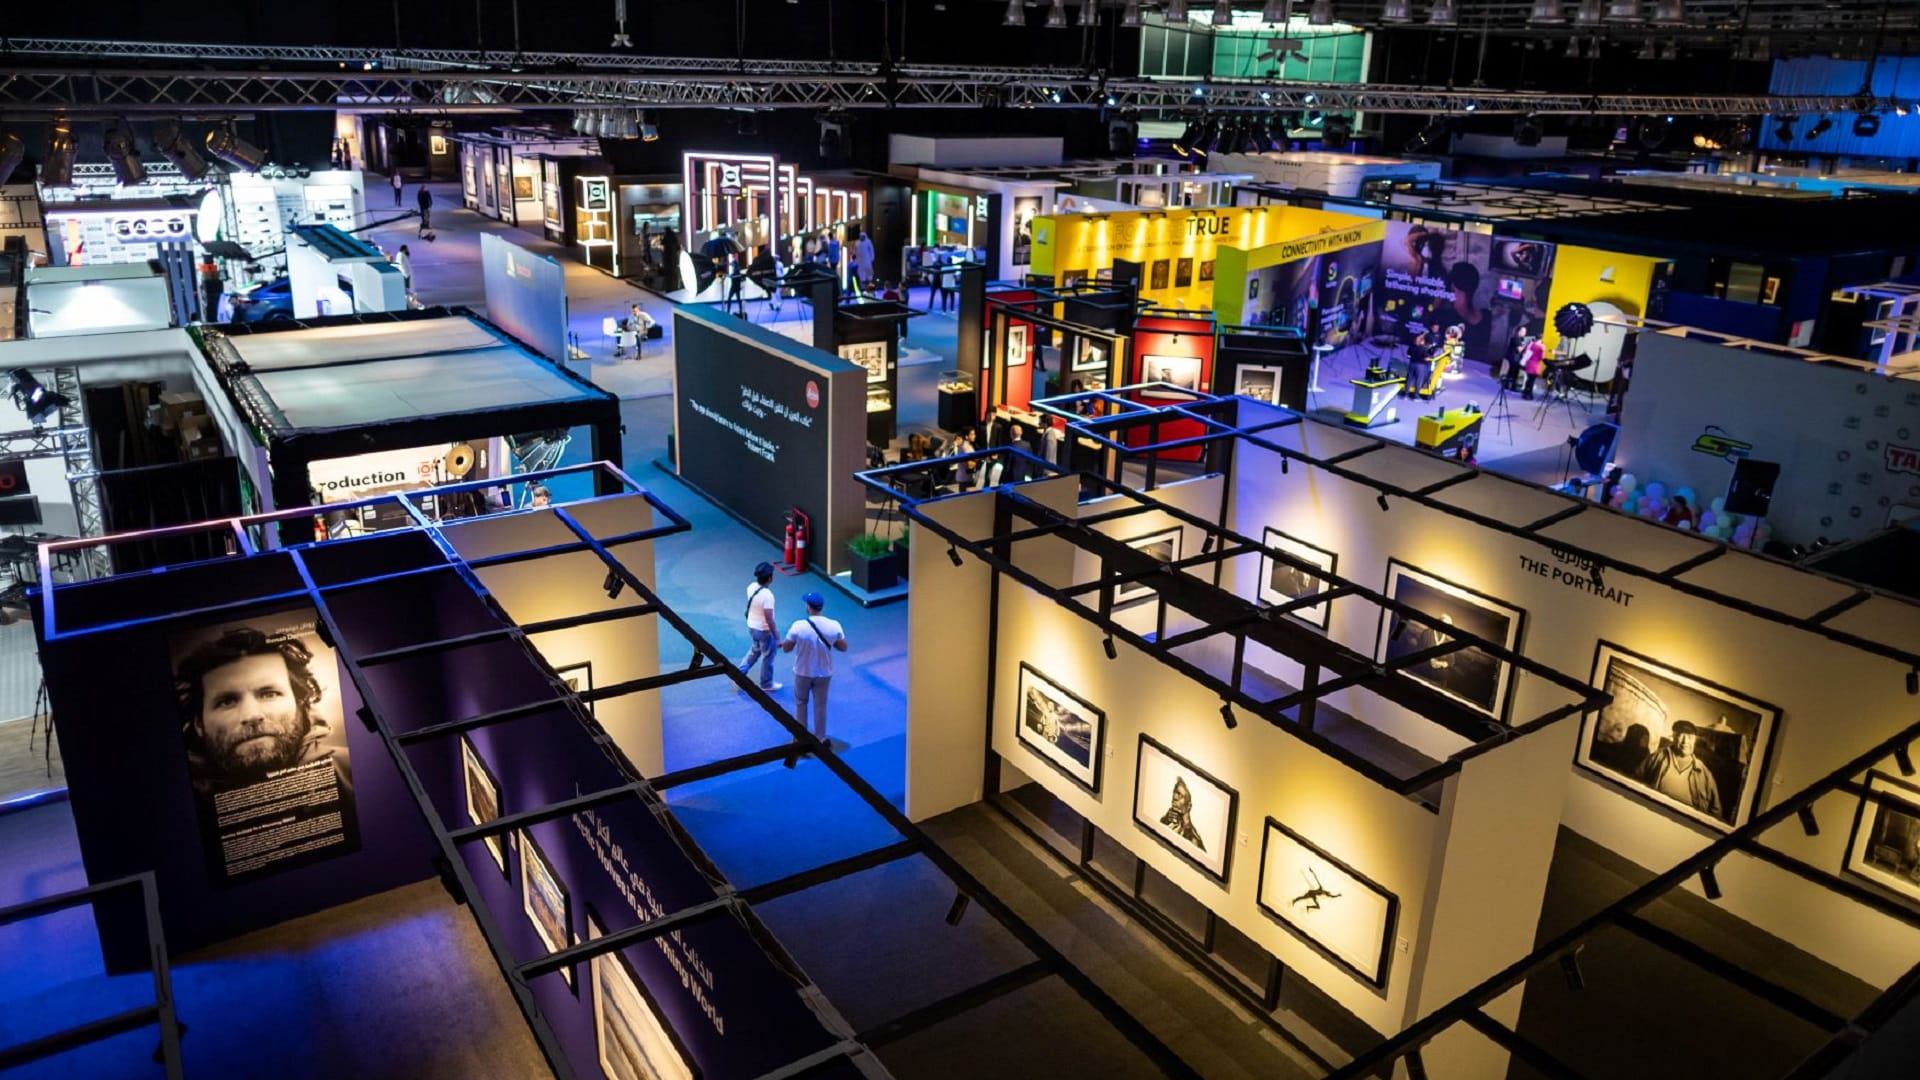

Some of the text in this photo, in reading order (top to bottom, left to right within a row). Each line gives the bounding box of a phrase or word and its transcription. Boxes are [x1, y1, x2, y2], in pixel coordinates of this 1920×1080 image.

[1186, 217, 1230, 236] TRUE
[1281, 230, 1362, 258] CONNECTIVITY WITH NIKON
[1519, 555, 1634, 607] THE PORTRAIT
[595, 839, 627, 896] Wolves
[636, 903, 644, 922] a
[690, 974, 724, 1036] World
